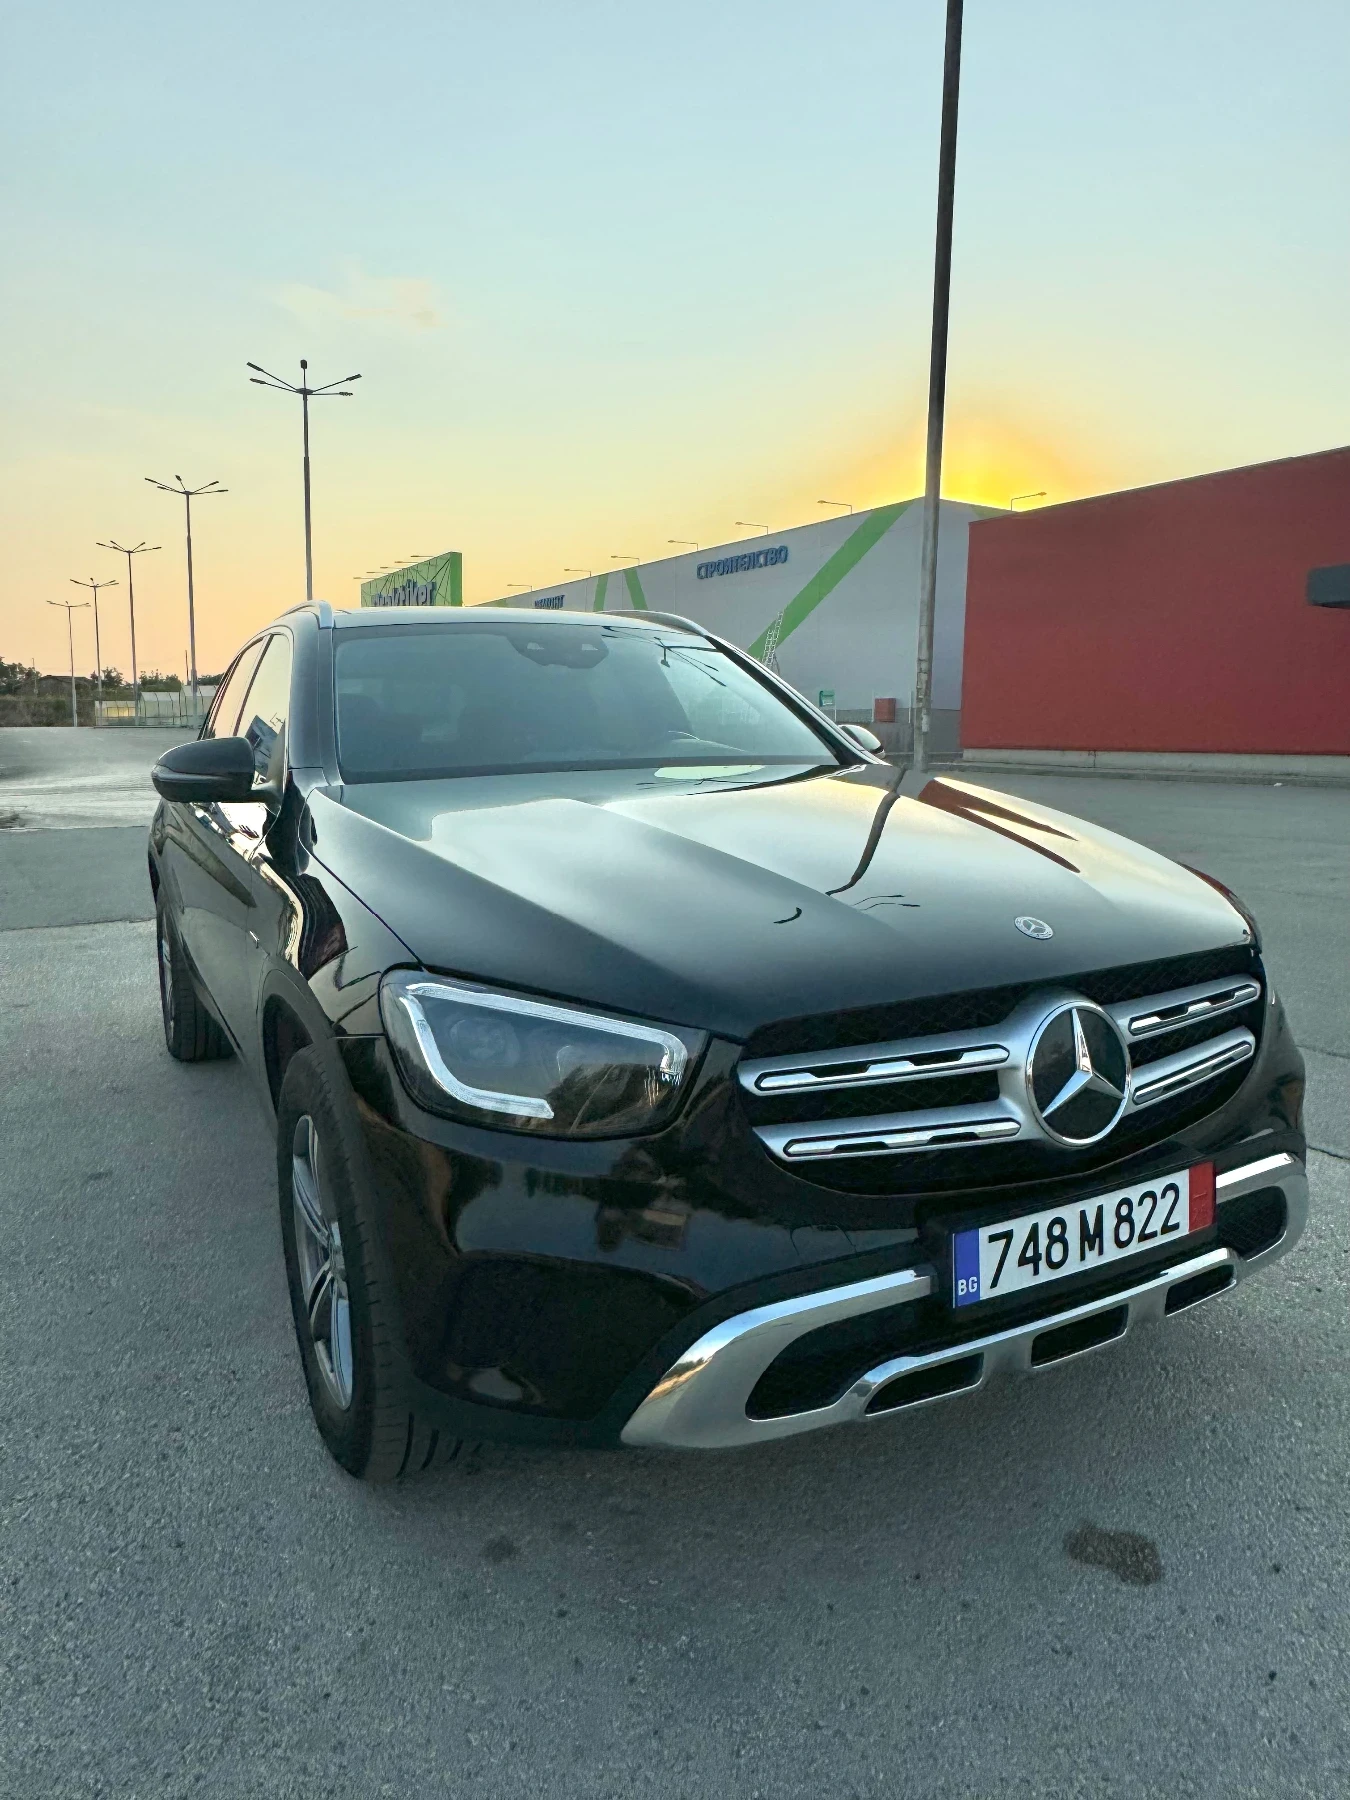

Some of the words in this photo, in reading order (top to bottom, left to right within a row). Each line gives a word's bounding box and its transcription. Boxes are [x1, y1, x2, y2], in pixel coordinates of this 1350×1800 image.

[697, 545, 788, 579] СТРОИТЕЛСТВО
[988, 1216, 1069, 1289] 748
[1079, 1204, 1104, 1262] M
[1114, 1182, 1180, 1249] 822
[957, 1276, 978, 1296] BG
